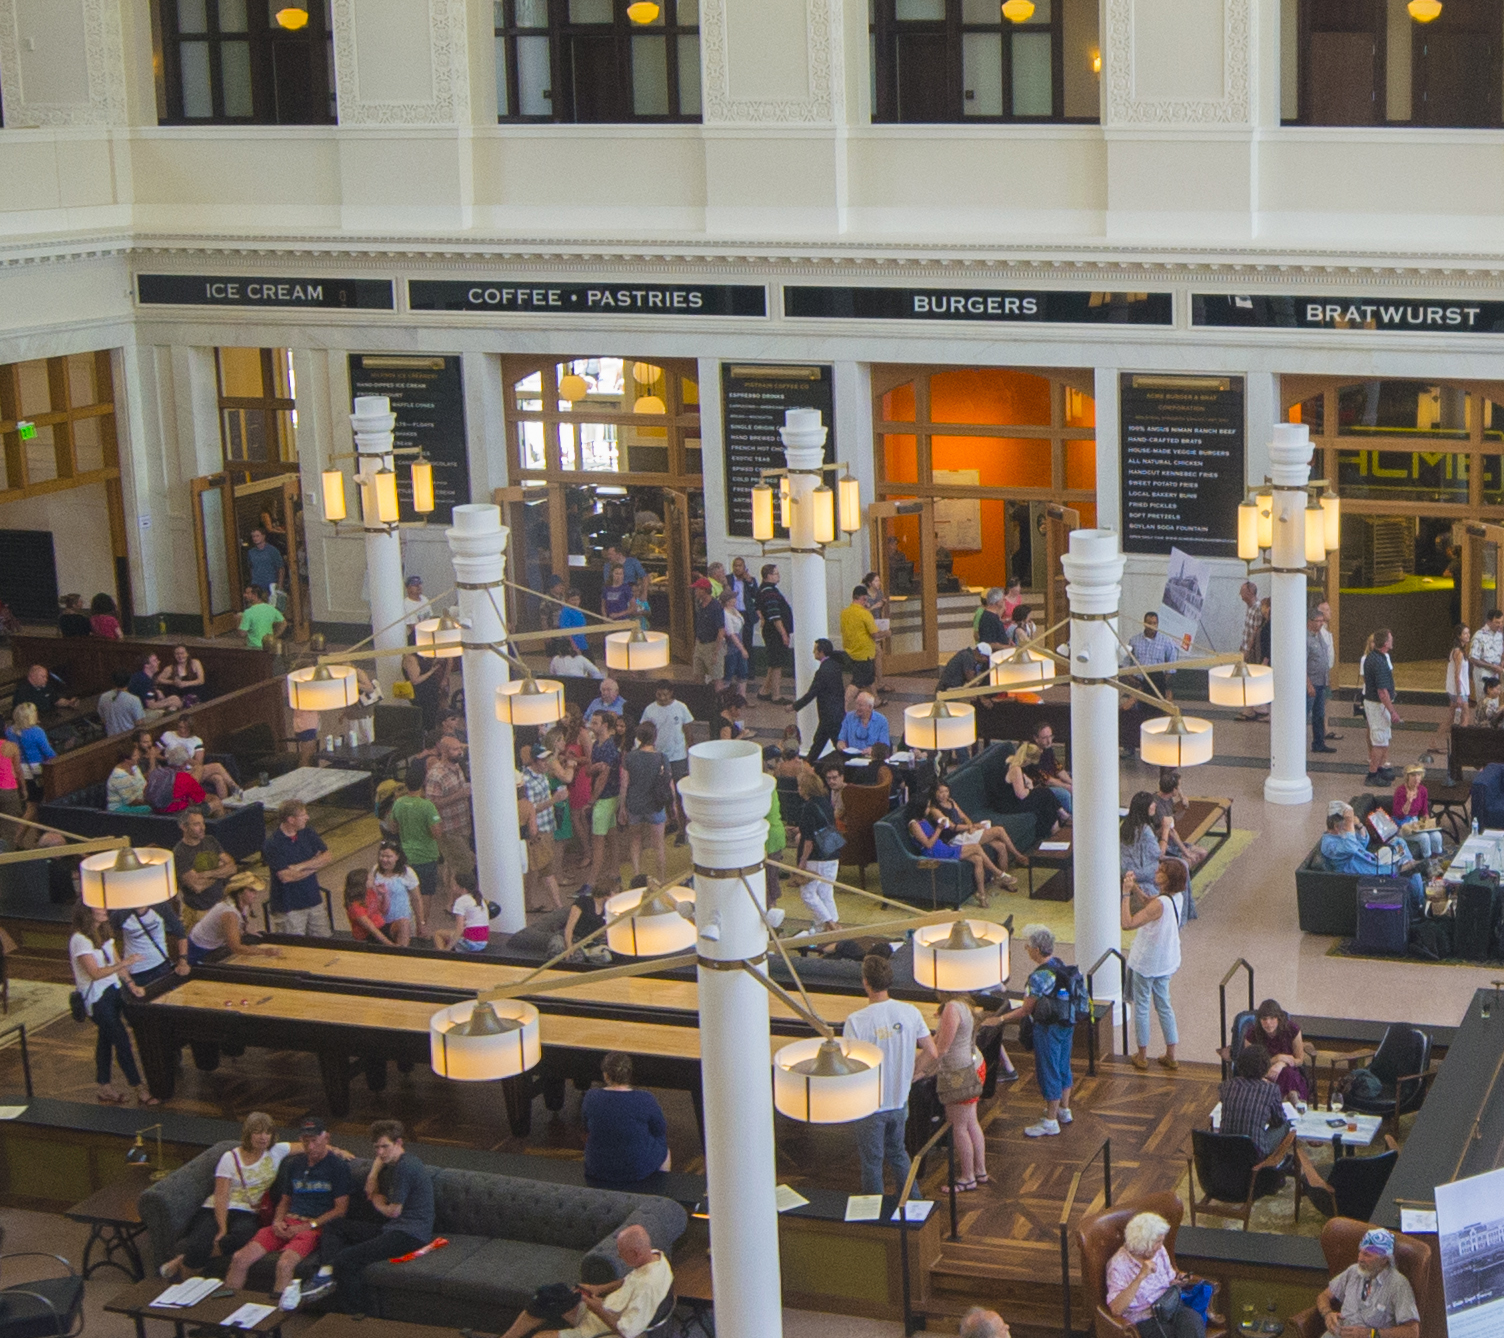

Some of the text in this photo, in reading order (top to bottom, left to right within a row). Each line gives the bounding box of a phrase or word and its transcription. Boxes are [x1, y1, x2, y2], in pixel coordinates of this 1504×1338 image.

[206, 283, 324, 301] ICE CREAM
[468, 288, 703, 307] COFFEE PASTRIES
[913, 295, 1038, 314] BURGERS
[1306, 304, 1480, 325] BRATWURST
